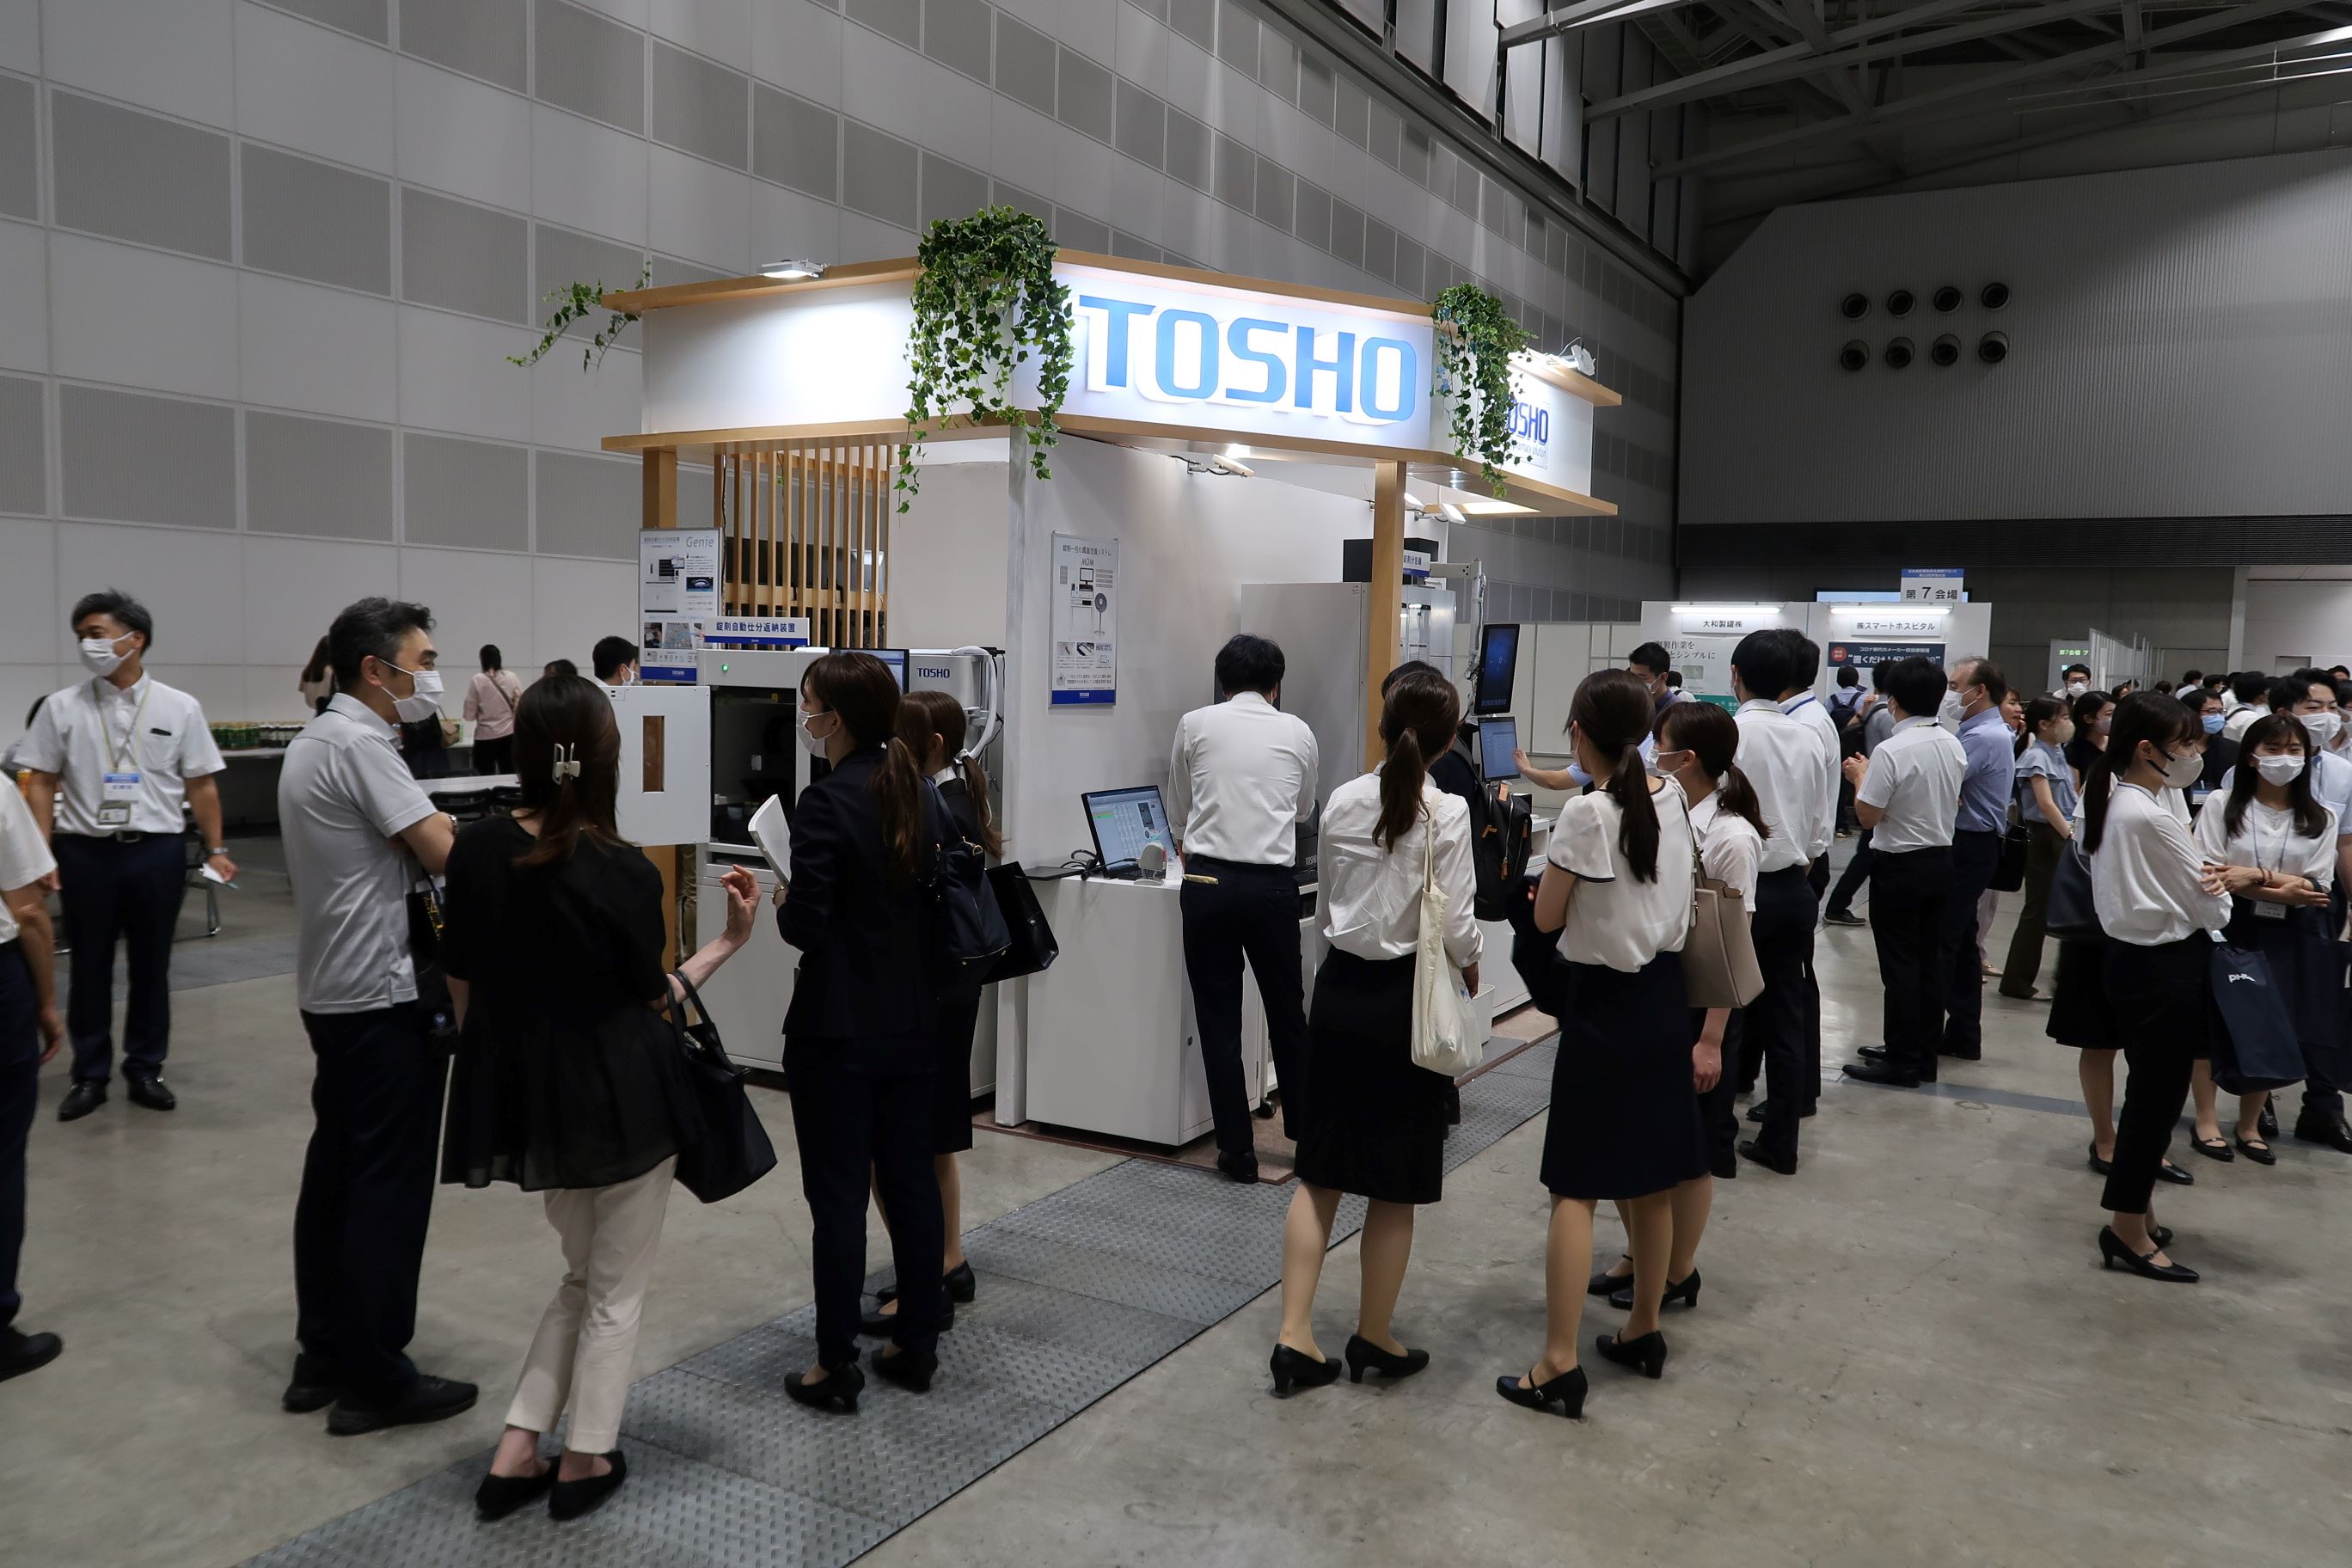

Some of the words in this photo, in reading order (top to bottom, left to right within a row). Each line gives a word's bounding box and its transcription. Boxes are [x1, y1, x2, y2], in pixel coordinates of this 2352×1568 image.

[1080, 295, 1417, 421] TOSHO
[1507, 397, 1548, 444] OSHO
[686, 536, 714, 548] Genie
[1081, 558, 1094, 567] MDM
[1656, 640, 1694, 650] 製作業を
[916, 667, 950, 678] TOSHO
